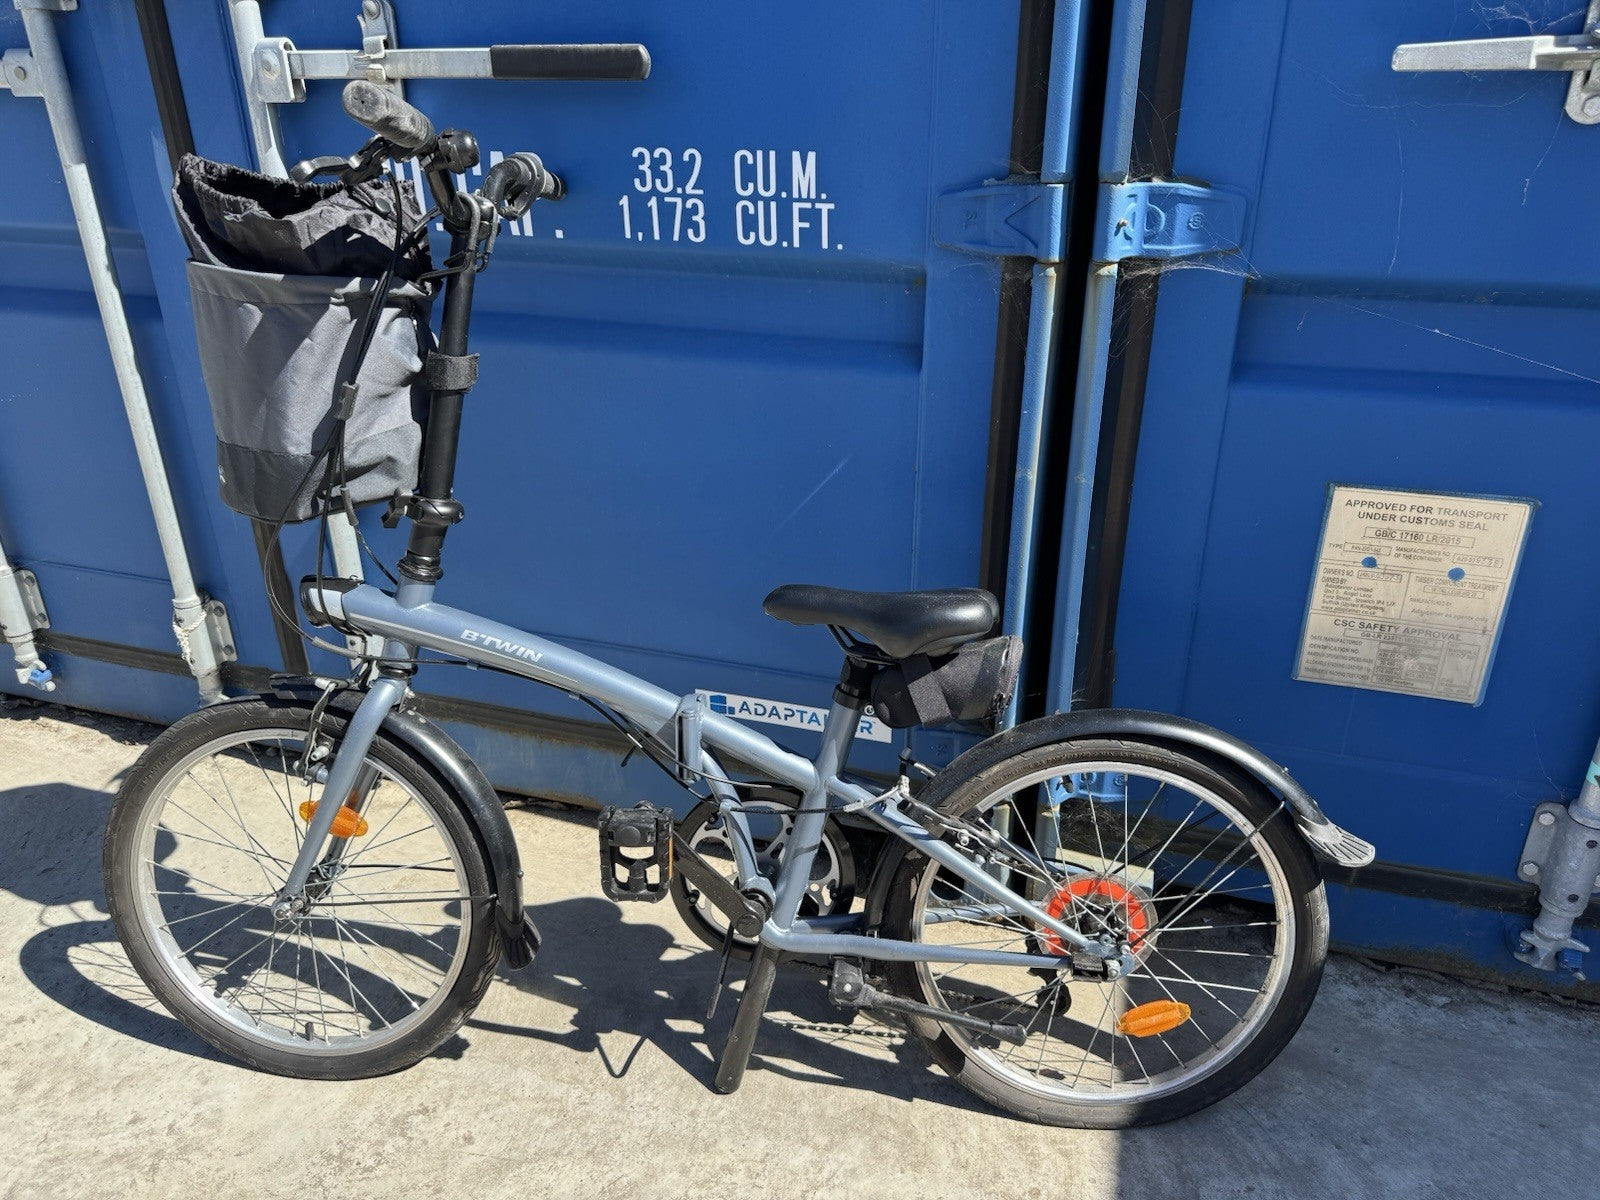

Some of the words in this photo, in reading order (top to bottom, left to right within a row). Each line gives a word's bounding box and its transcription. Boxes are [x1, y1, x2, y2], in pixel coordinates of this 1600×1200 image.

[631, 146, 704, 195] 33.2
[734, 149, 827, 199] CU.M.
[735, 200, 843, 250] CU.FT.
[1345, 498, 1406, 511] APPROVED
[1409, 504, 1433, 514] FOR
[1435, 507, 1508, 521] TRANSPORT
[1357, 510, 1396, 521] UNDER
[1399, 515, 1455, 527] CUSTOMS
[1458, 520, 1489, 530] SEAL
[1374, 529, 1397, 538] GB/C
[1399, 532, 1423, 541] 17160
[1425, 534, 1461, 545] LR/2015
[1333, 618, 1355, 627] CSC
[1358, 621, 1399, 633] SAFETY
[1402, 627, 1463, 641] APPROVAL
[739, 701, 874, 735] ADAPTAIR
